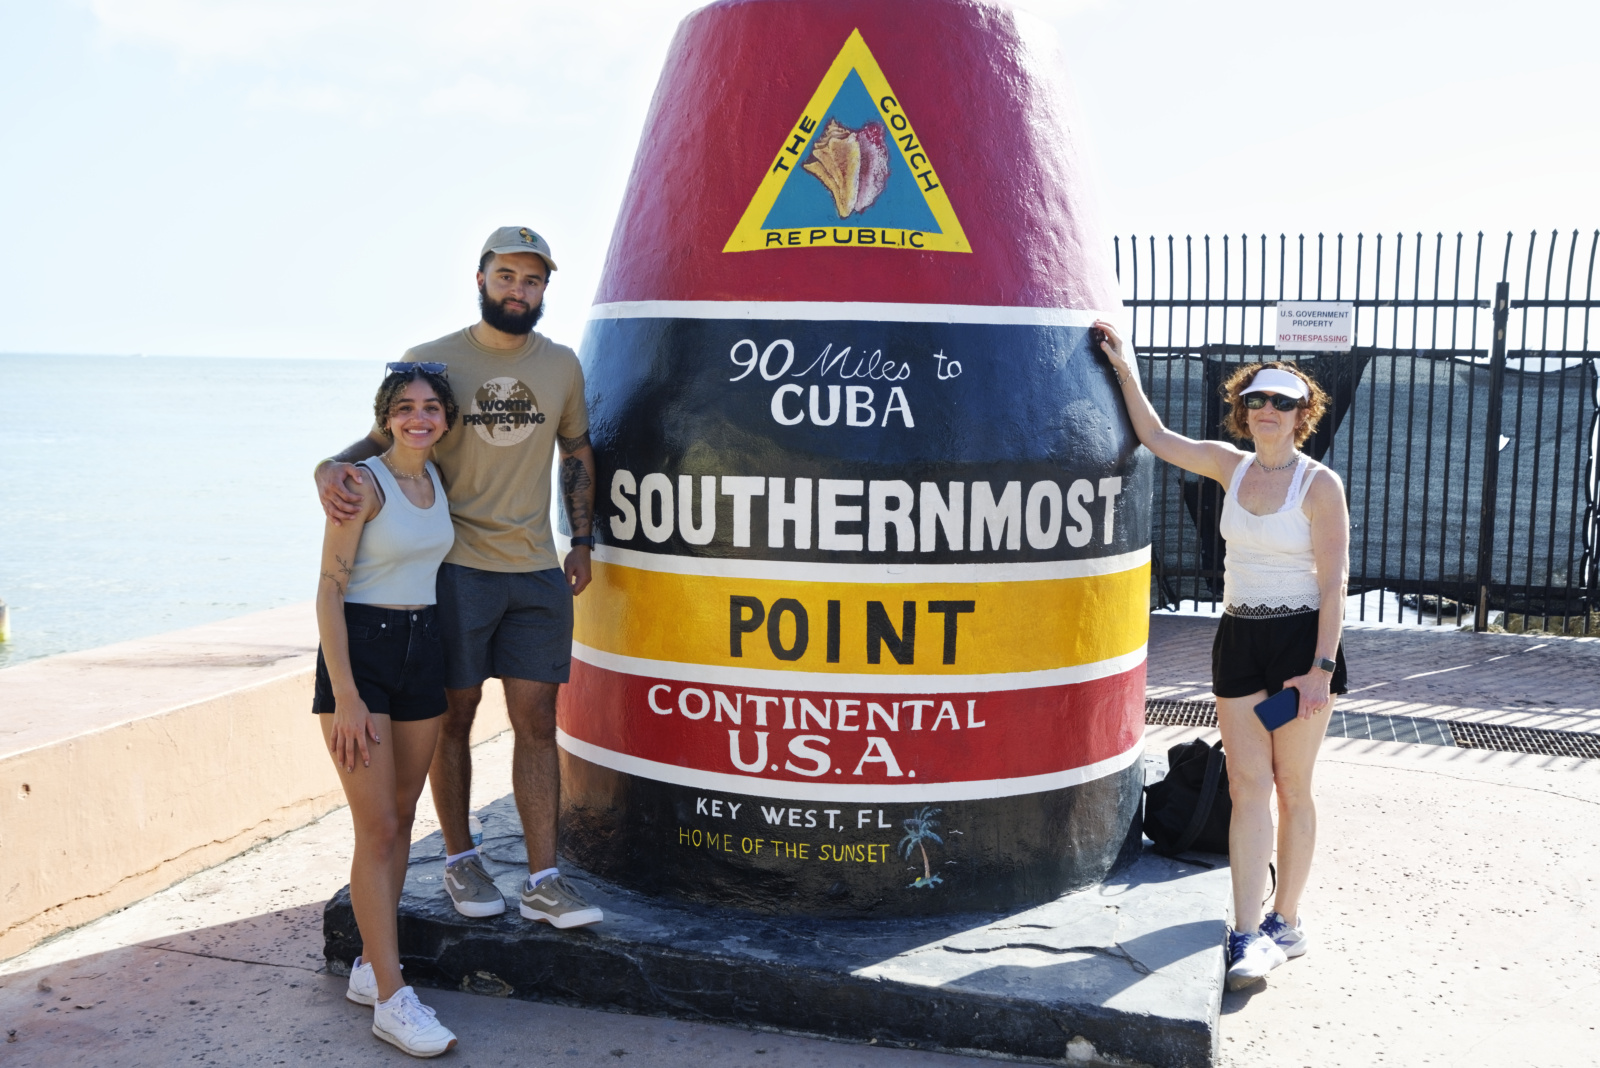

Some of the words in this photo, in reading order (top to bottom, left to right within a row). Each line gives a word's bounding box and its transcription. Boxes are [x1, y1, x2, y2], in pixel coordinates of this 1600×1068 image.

[772, 115, 817, 174] THE
[880, 95, 939, 192] CONCH
[765, 229, 924, 248] REPUBLIC
[1280, 310, 1294, 318] U.S.
[1295, 310, 1349, 318] GOVERNMENT
[729, 338, 795, 381] 90
[791, 343, 911, 381] Miles
[933, 349, 962, 380] to
[1293, 334, 1347, 342] TRESPASSING
[463, 412, 546, 426] PROTECTING
[479, 399, 532, 412] WORTH
[770, 383, 915, 428] CUBA
[609, 469, 1122, 553] SOUTHERNMOST
[729, 595, 975, 665] POINT
[647, 684, 986, 732] CONTINENTAL
[728, 730, 916, 778] U.S.A.
[696, 797, 742, 820] KEY
[761, 805, 844, 832] WEST,
[857, 809, 892, 829] FL
[679, 826, 733, 852] HOME
[741, 837, 765, 855] OF
[770, 840, 810, 860] THE
[818, 844, 890, 863] SUNSET
